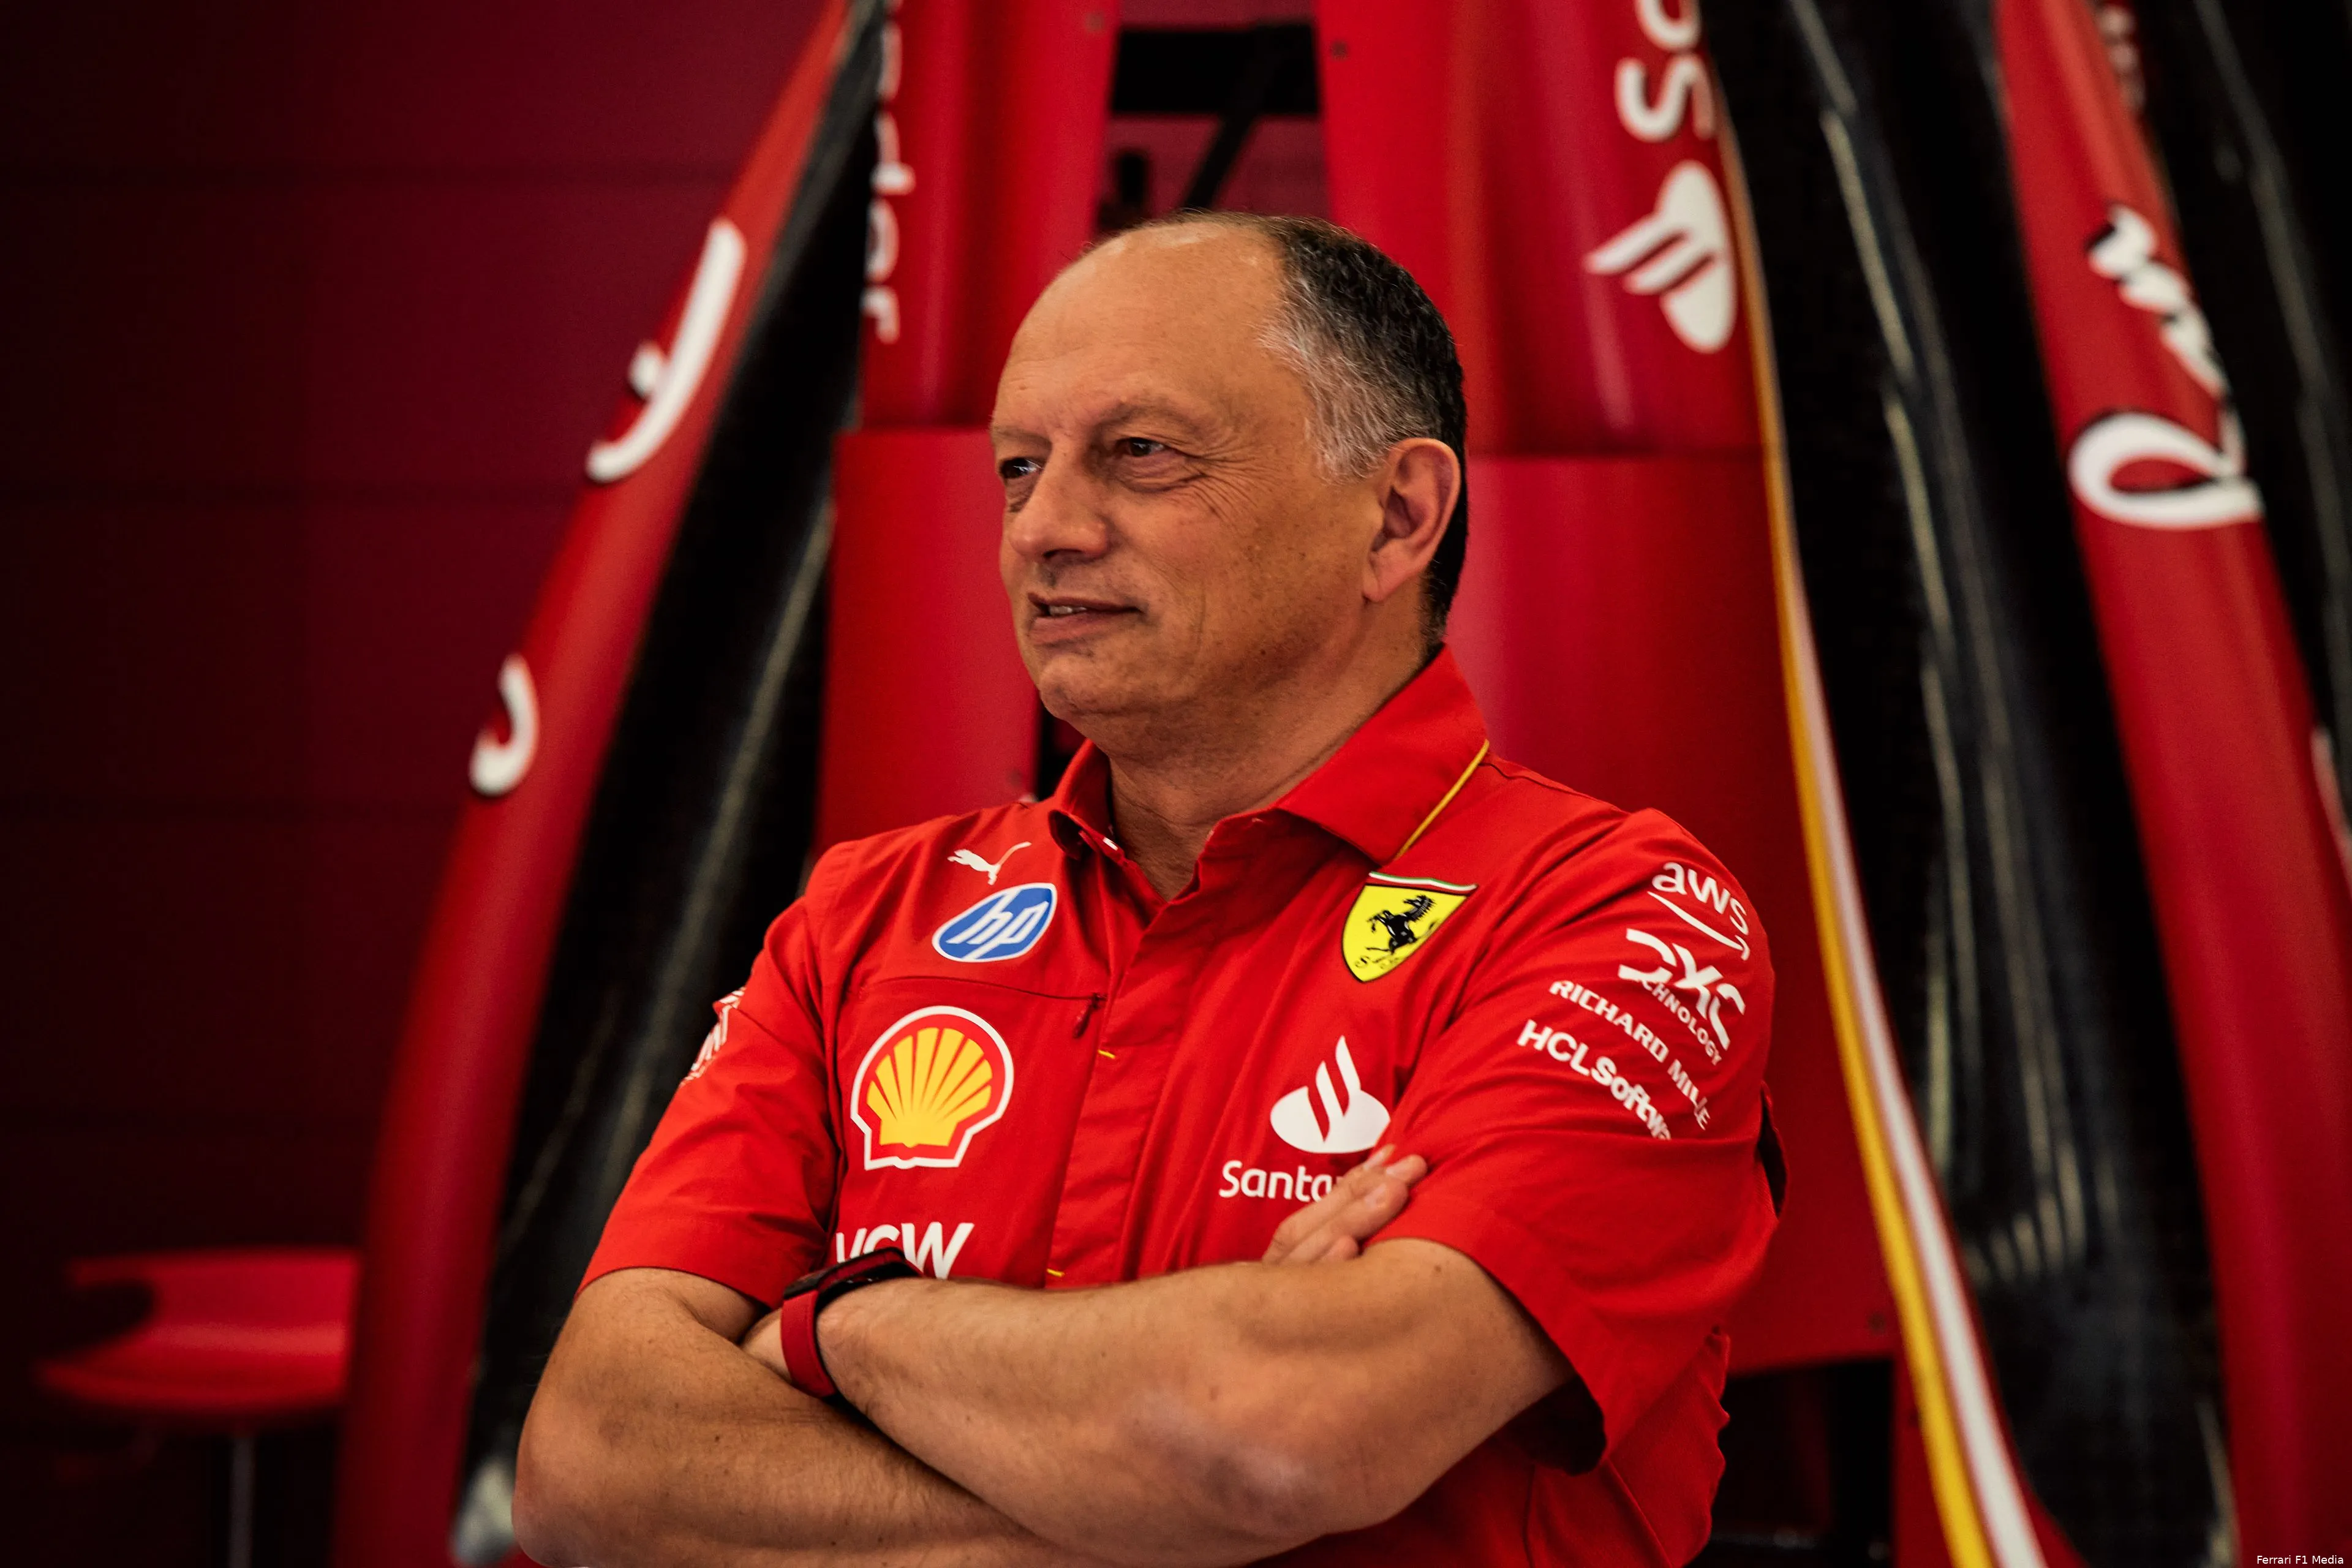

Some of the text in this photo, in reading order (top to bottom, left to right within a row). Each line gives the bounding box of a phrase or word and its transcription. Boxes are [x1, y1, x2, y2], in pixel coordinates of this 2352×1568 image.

[946, 888, 1049, 960] hp
[1549, 980, 1670, 1063] RICHARD
[1218, 1159, 1340, 1203] Santa
